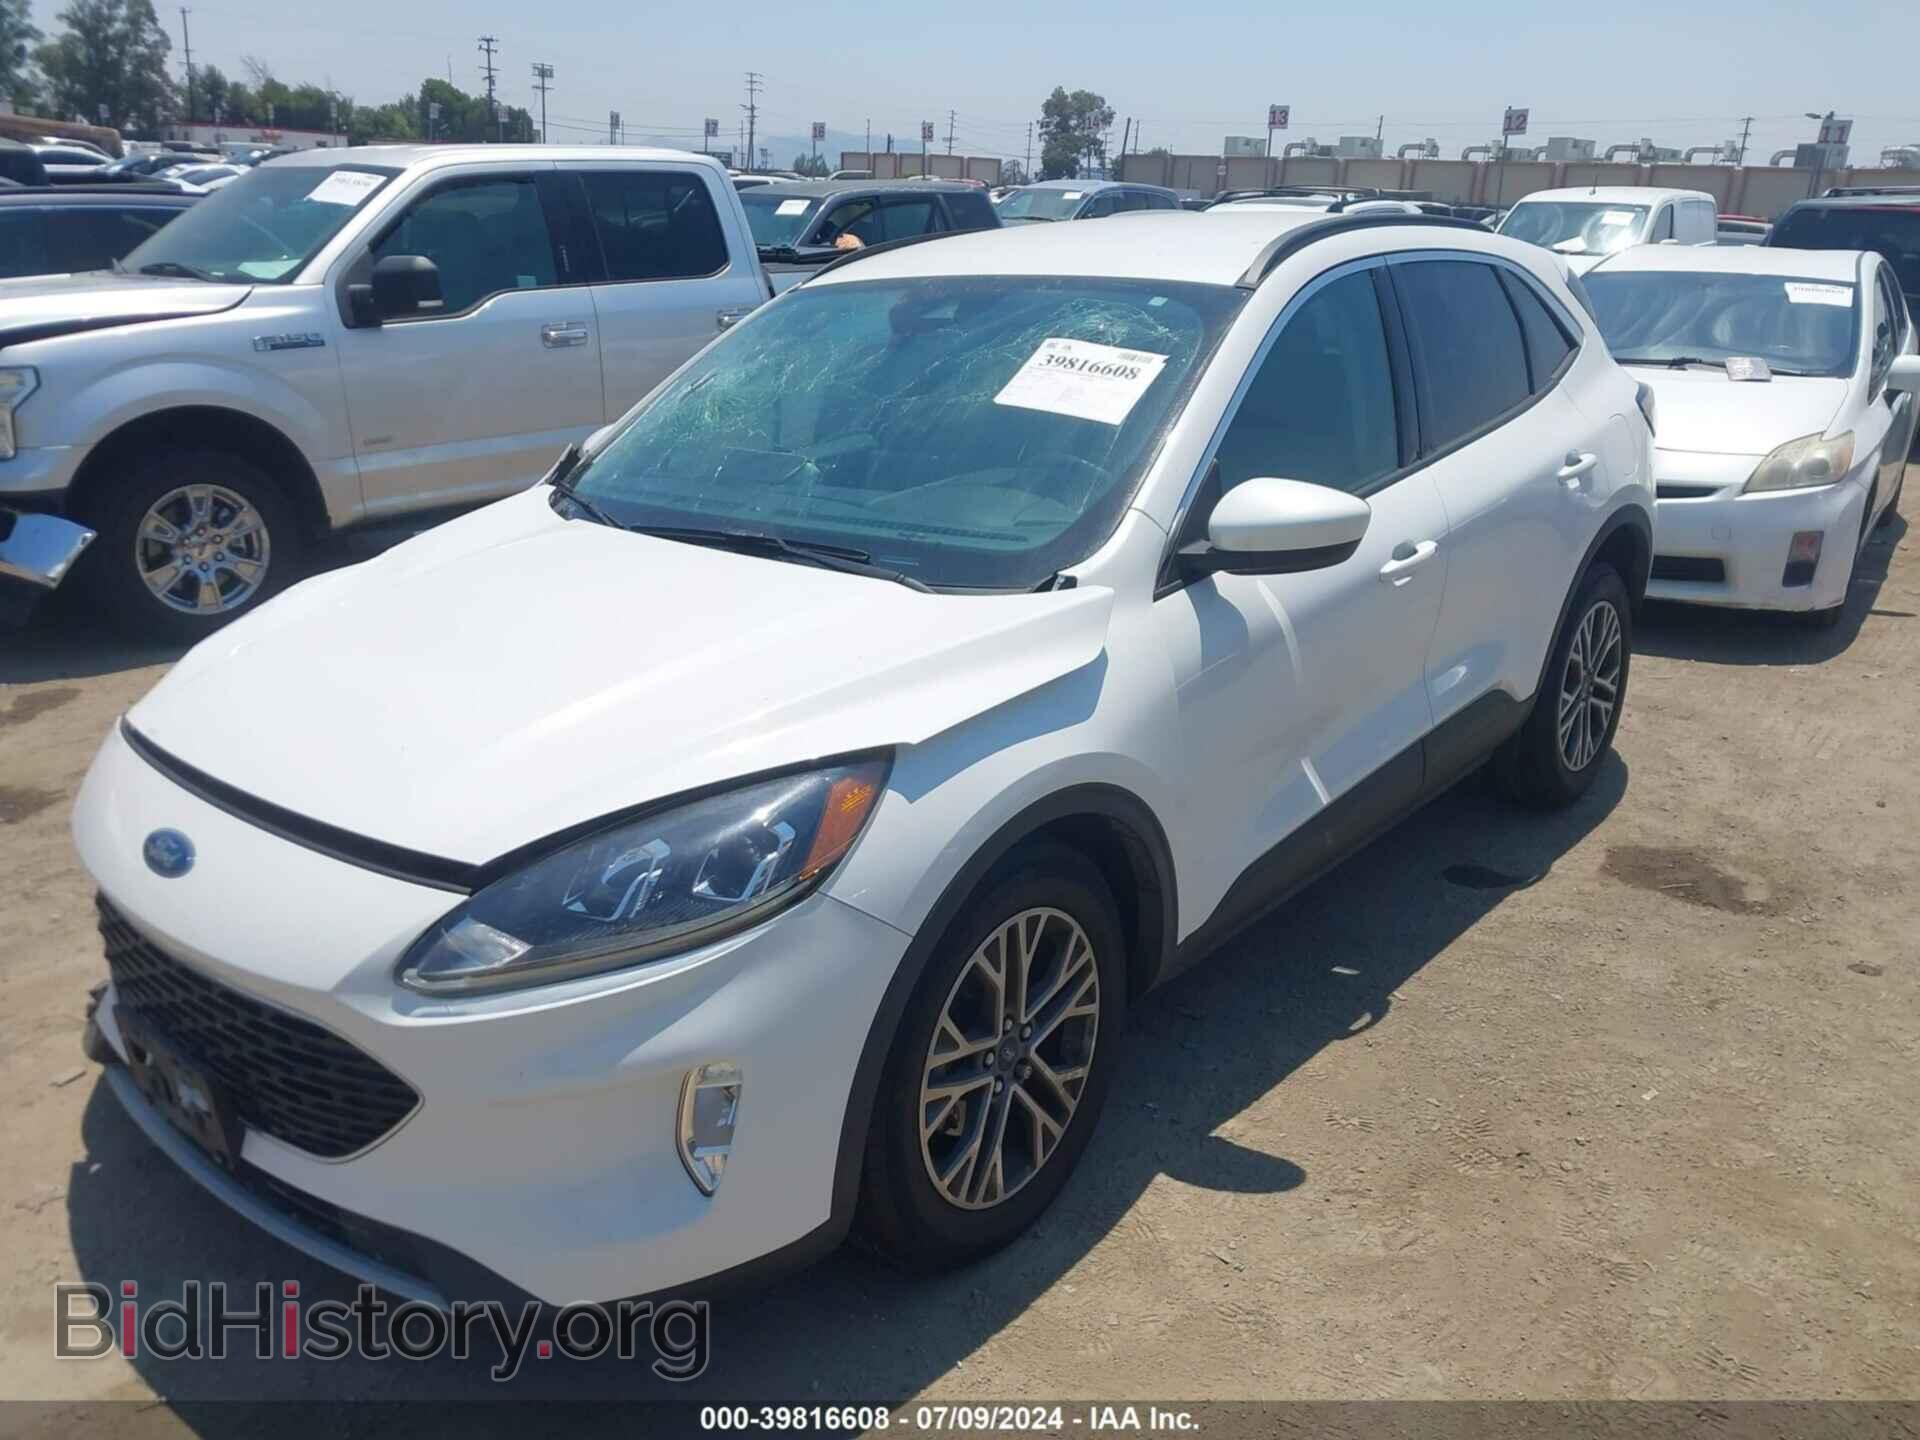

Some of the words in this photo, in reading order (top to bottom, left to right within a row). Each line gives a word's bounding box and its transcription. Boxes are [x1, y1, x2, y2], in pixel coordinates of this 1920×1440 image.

[1269, 110, 1289, 125] 13
[1504, 113, 1527, 131] 12
[812, 126, 825, 139] 16
[922, 125, 934, 139] 15
[1819, 126, 1848, 144] 11
[1038, 354, 1142, 380] 39816608
